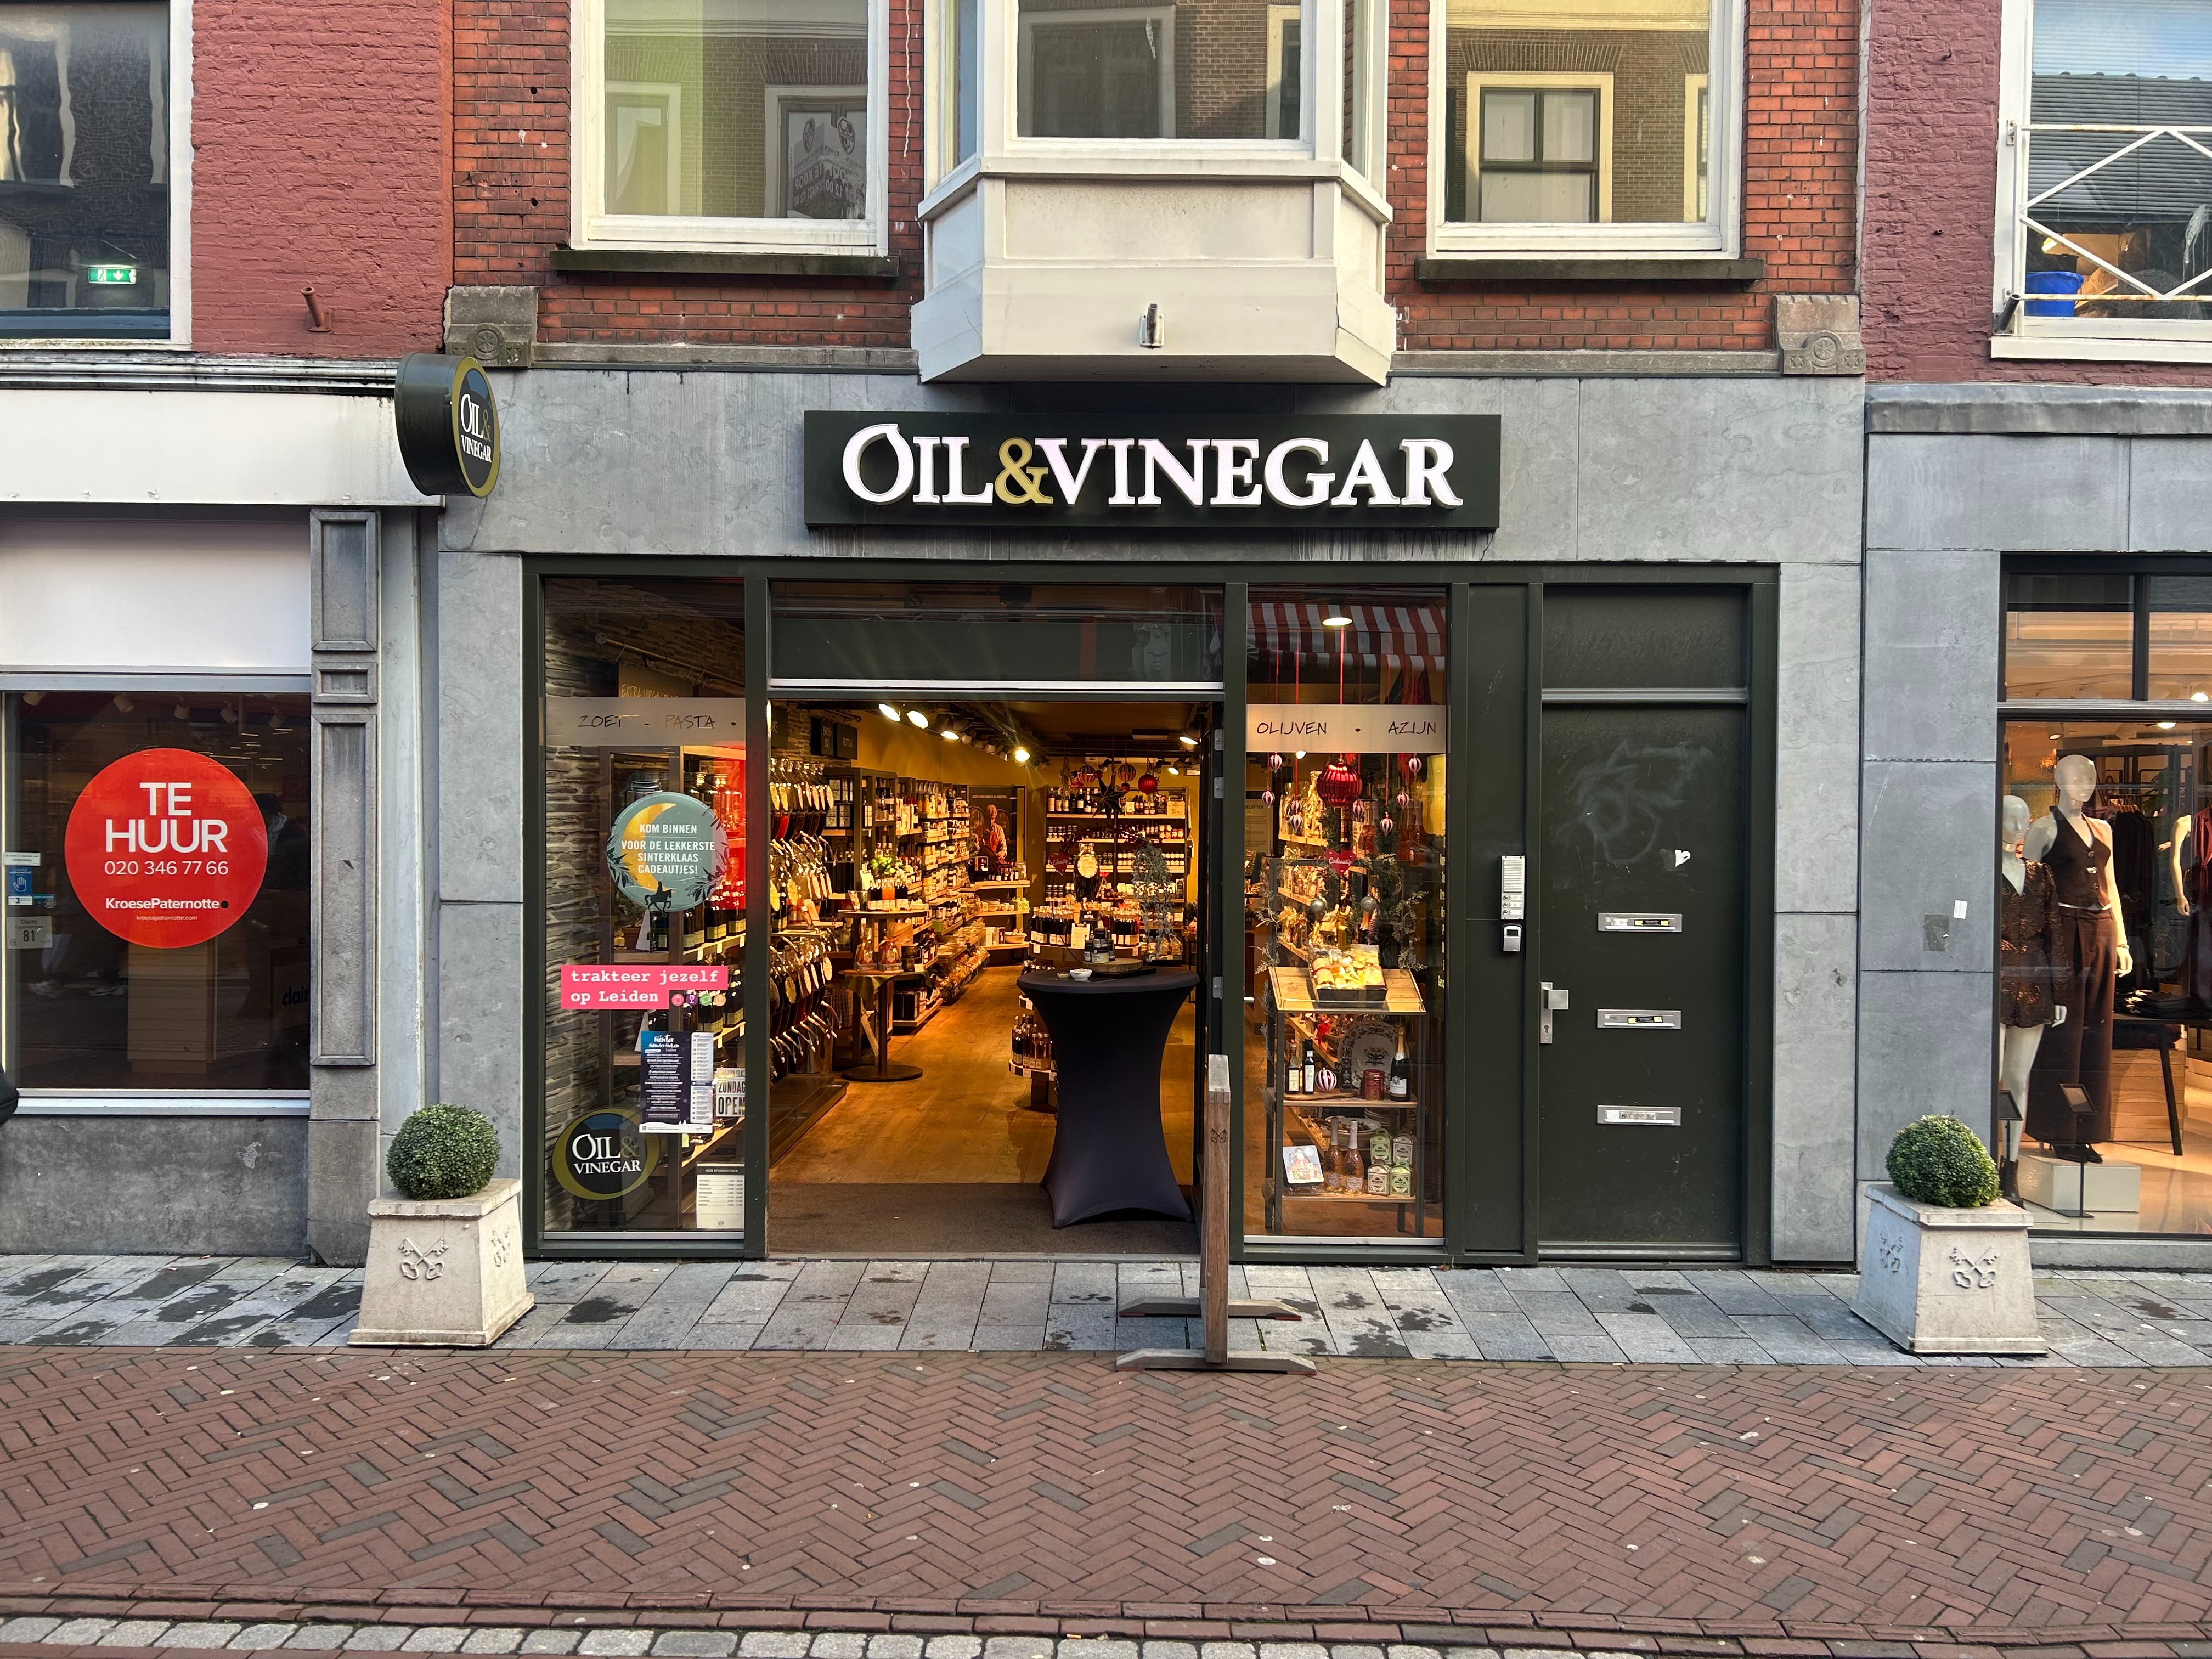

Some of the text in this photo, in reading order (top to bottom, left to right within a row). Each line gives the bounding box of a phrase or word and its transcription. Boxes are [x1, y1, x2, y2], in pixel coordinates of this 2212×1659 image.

[461, 434, 492, 463] VINEGAR
[842, 423, 1464, 510] OIL&VINEGAR
[578, 714, 715, 729] ZOET PASTA
[1256, 721, 1437, 735] OLIJVEN AZIJN
[139, 782, 192, 816] TE
[105, 819, 228, 853] HUUR
[640, 823, 697, 834] KOM BINNEN
[621, 840, 715, 851] VOOR DE LEKKERSTE
[637, 853, 699, 863] SINTERKLAAS
[104, 860, 229, 876] 020 346 77 66
[637, 865, 698, 874] CADEAUTJES!
[105, 898, 220, 910] KroesePaternotte
[23, 930, 35, 943] 81
[571, 970, 719, 985] trakteer jezelf
[570, 990, 659, 1005] op Leiden
[718, 1081, 746, 1093] ZONDAG
[718, 1097, 746, 1115] OPEN
[573, 1160, 642, 1175] VINEGAR
